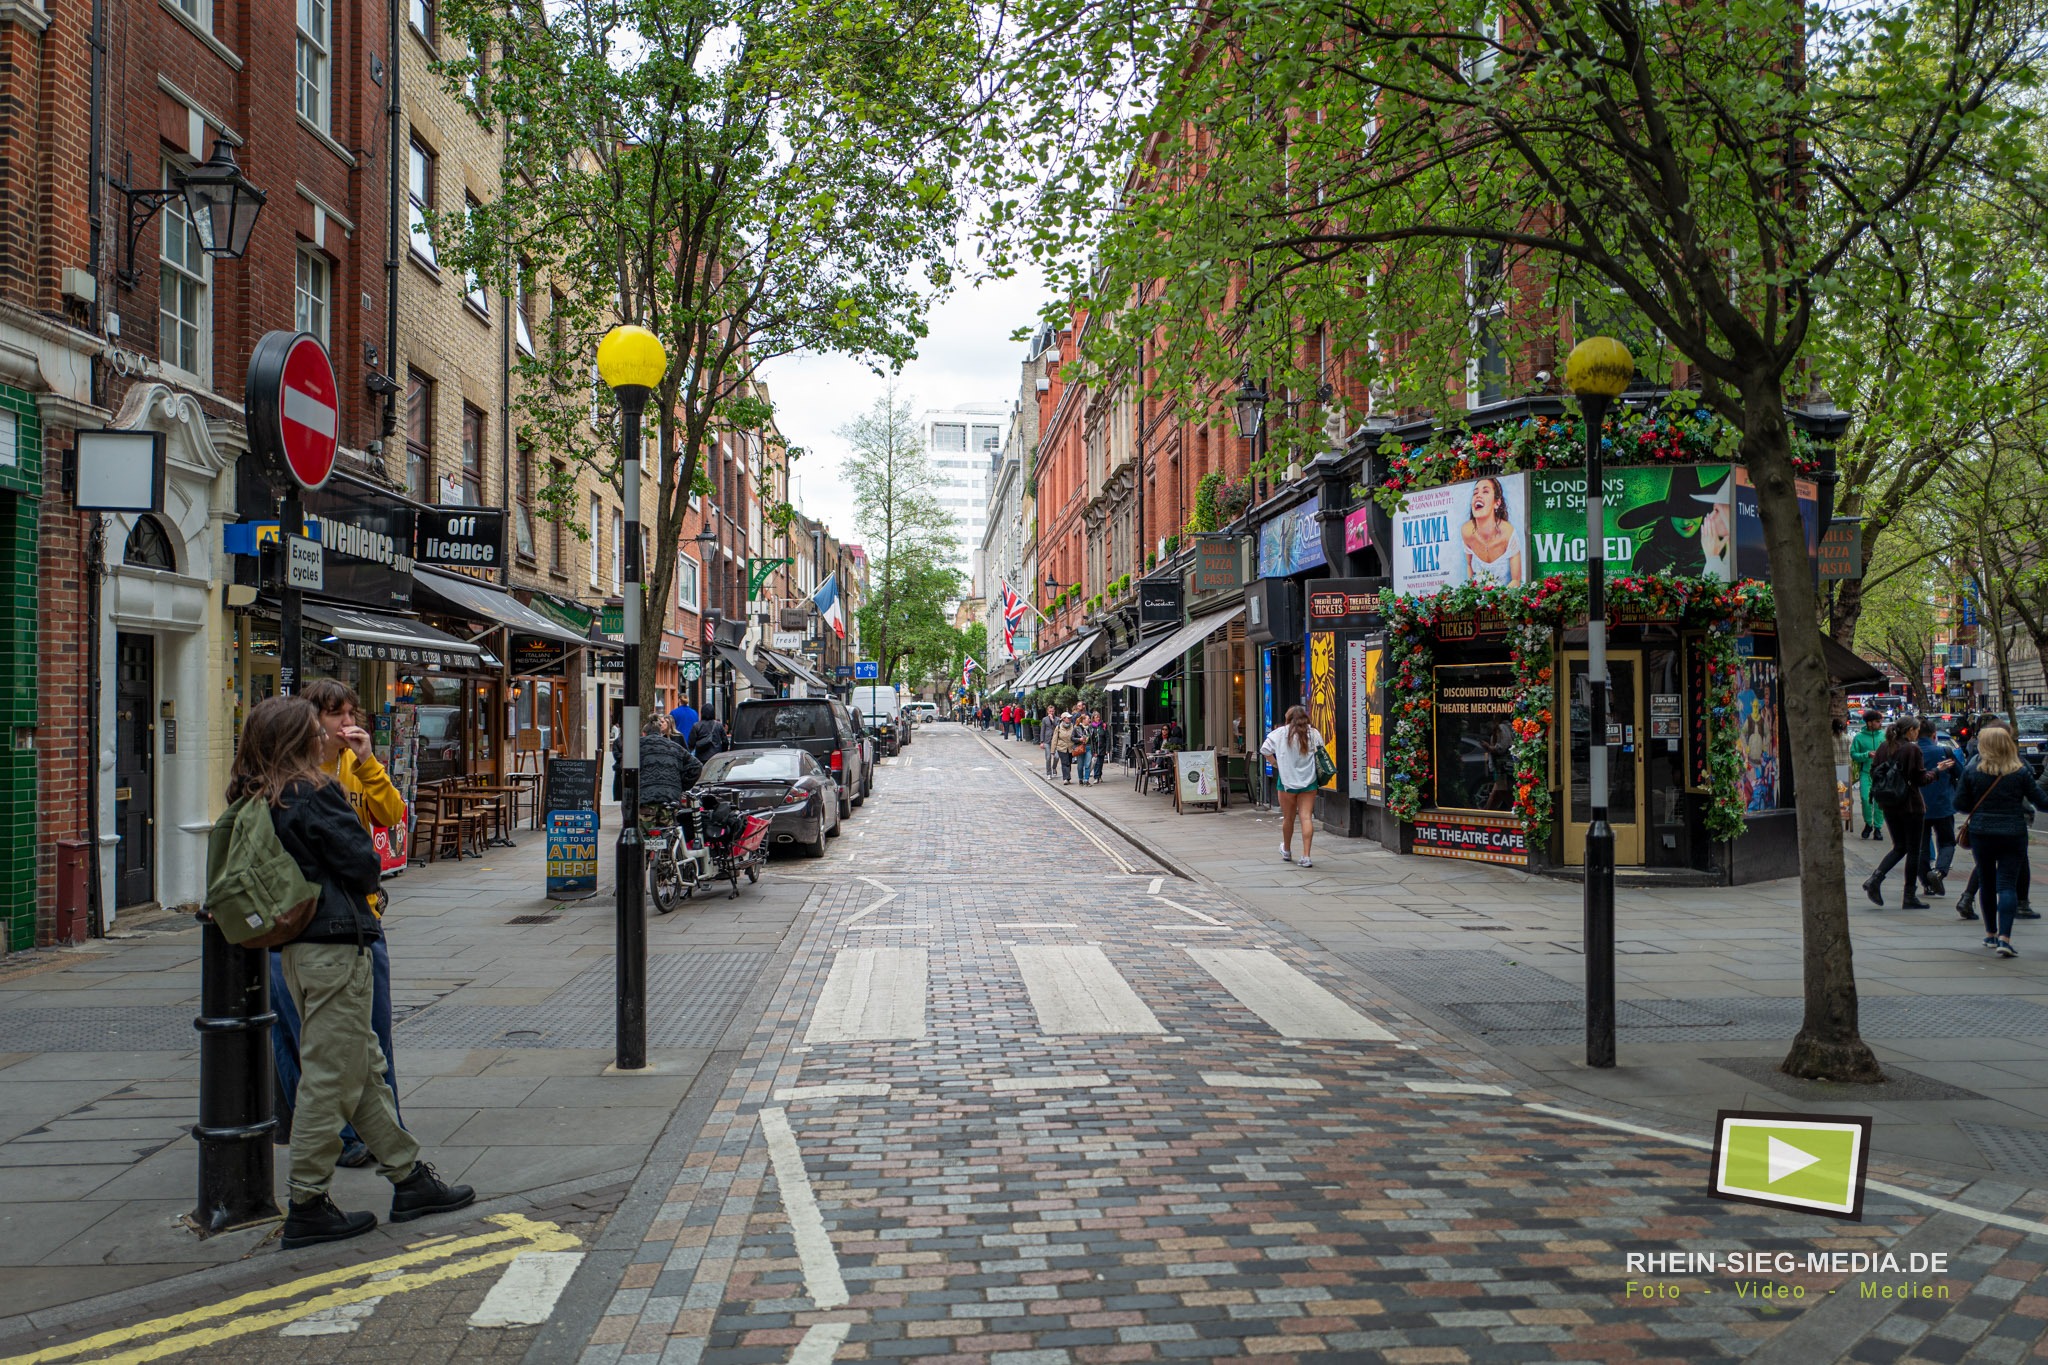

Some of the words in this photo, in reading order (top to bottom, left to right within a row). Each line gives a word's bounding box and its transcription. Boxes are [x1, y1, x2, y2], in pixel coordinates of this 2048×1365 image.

[1535, 478, 1624, 493] "LONDN'S
[1435, 490, 1450, 498] KNOW
[1545, 494, 1562, 509] #1
[1566, 494, 1624, 508] SHW."
[1738, 502, 1755, 517] TIME
[448, 516, 476, 536] off
[1402, 516, 1449, 548] MAMMA
[292, 544, 320, 564] Except
[426, 538, 494, 562] licence
[1202, 543, 1236, 556] GRILLS
[1534, 532, 1632, 563] WICED
[1205, 558, 1233, 570] PIZZA
[1412, 544, 1440, 573] MIA!
[293, 566, 318, 582] cycles
[1818, 562, 1852, 575] ASTA
[1204, 574, 1235, 586] PASTA
[1314, 604, 1343, 614] TICKETS
[1440, 622, 1473, 636] TICKETS
[776, 636, 798, 645] fresh
[356, 644, 373, 658] LICENCE
[390, 648, 398, 660] TOP
[398, 648, 407, 661] UPS
[429, 651, 440, 664] CREAM
[454, 654, 462, 666] SOFT
[462, 655, 475, 667] DRINKS
[1444, 688, 1488, 698] DISCOUNTED
[1440, 703, 1470, 713] THEATRE
[1416, 827, 1438, 840] THE
[1440, 829, 1489, 844] THEATRE
[1492, 834, 1524, 848] CAFE
[549, 845, 595, 860] ATM
[549, 862, 595, 876] HERE
